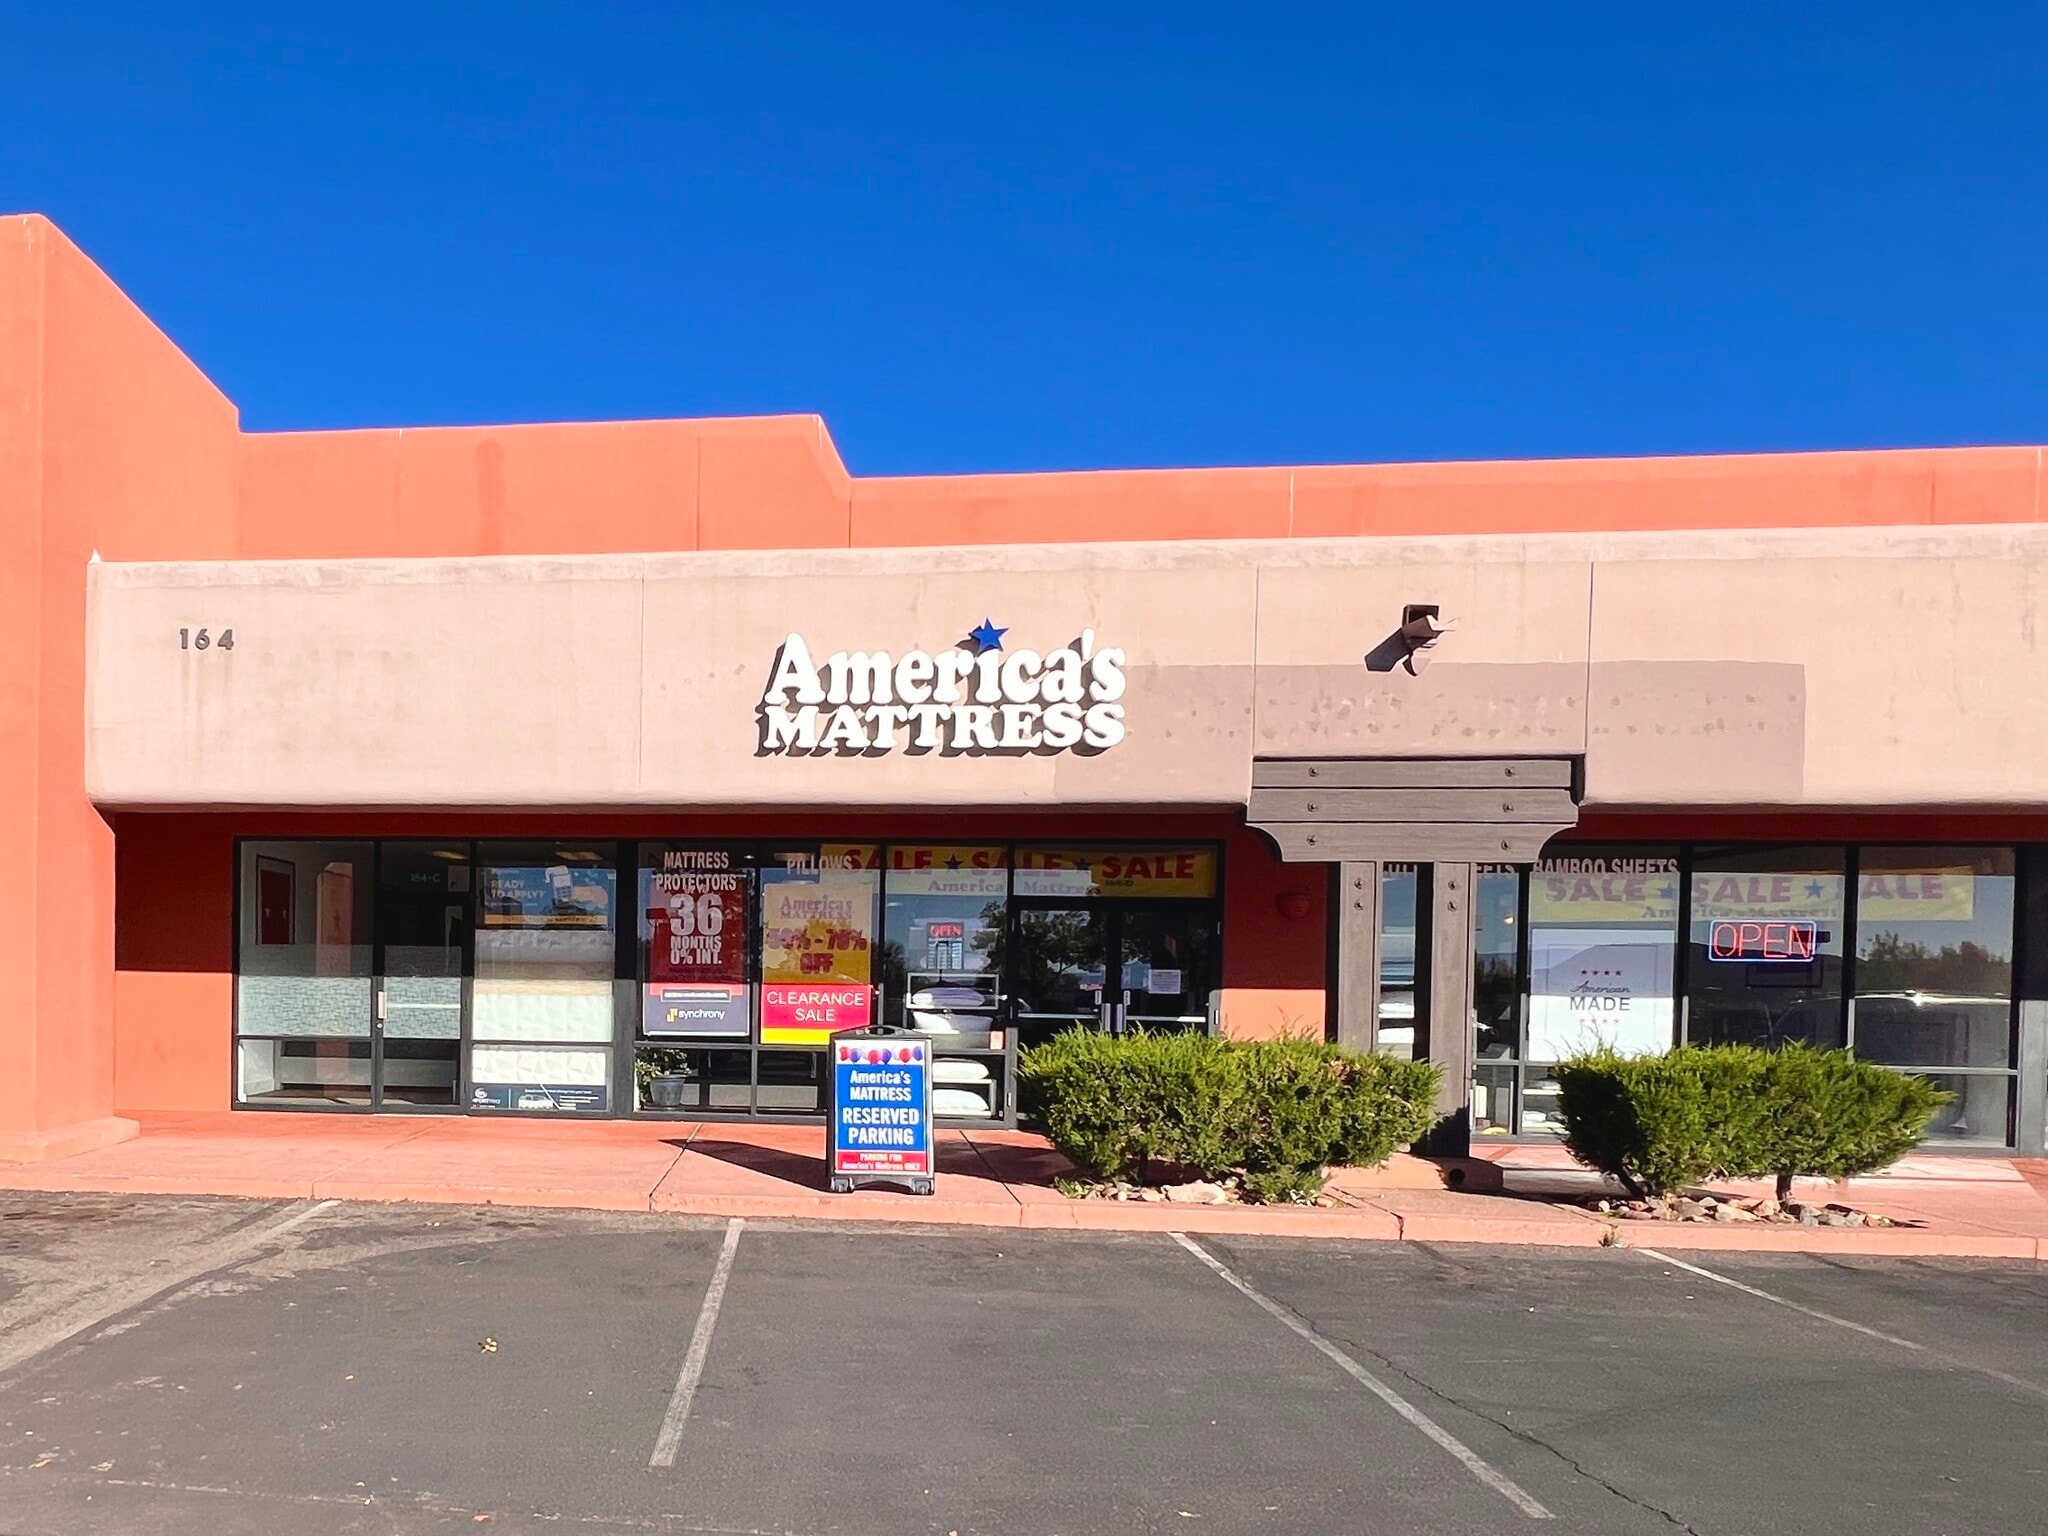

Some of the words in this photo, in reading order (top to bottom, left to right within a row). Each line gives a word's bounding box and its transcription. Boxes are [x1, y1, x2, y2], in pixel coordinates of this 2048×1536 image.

[179, 628, 234, 650] 164
[764, 622, 1126, 704] America's
[763, 703, 1126, 749] MATTRESS
[664, 851, 729, 869] MATTRESS
[787, 855, 852, 875] PILLOWS
[844, 849, 933, 875] SALE
[1102, 855, 1195, 879] SALE
[656, 873, 737, 890] PROTECTORS
[928, 879, 1006, 892] America
[1546, 877, 1646, 902] SALE
[1692, 876, 1792, 902] SALE
[670, 893, 723, 935] 36
[670, 936, 721, 949] MONTHS
[1714, 924, 1813, 958] OPEN
[670, 949, 693, 964] 0%
[696, 949, 722, 964] INT.
[800, 952, 834, 974] OFF
[1570, 980, 1631, 993] American
[767, 991, 864, 1006] CLEARANCE
[1570, 996, 1631, 1010] MADE
[678, 1008, 725, 1020] synchrony
[795, 1008, 836, 1022] SALE
[850, 1069, 911, 1084] America's
[850, 1086, 912, 1101] MATTRESS
[842, 1107, 920, 1125] RESERVED
[848, 1128, 914, 1145] PARKING
